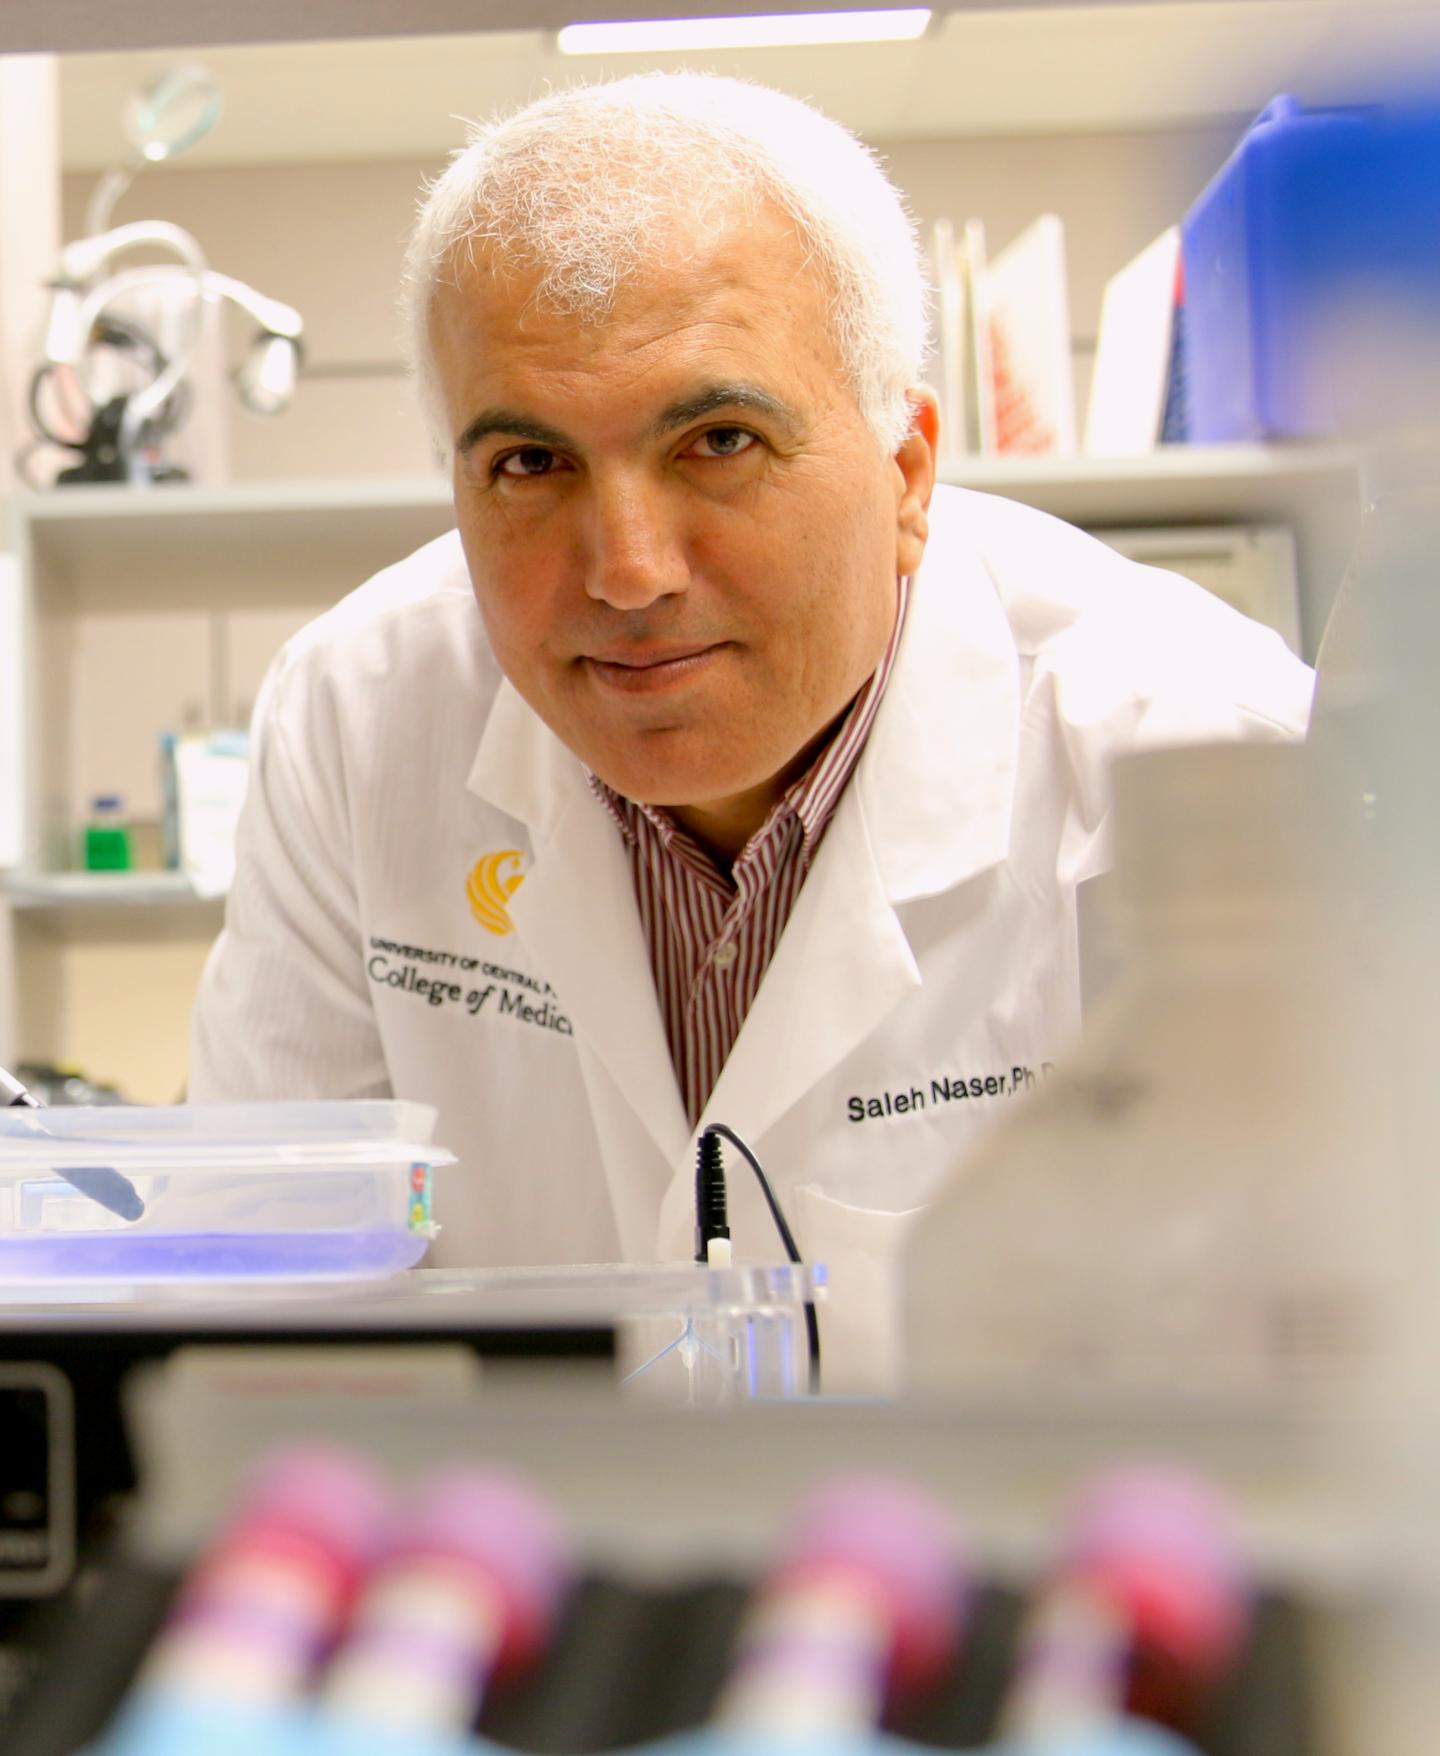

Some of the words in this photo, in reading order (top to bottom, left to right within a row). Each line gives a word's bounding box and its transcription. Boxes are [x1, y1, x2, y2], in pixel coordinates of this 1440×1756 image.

[368, 956, 462, 1006] College
[466, 985, 496, 1014] of
[370, 937, 458, 966] UNIVERSITY
[459, 957, 479, 970] OF
[481, 963, 541, 994] CENTRAL
[848, 1087, 925, 1122] Saleh
